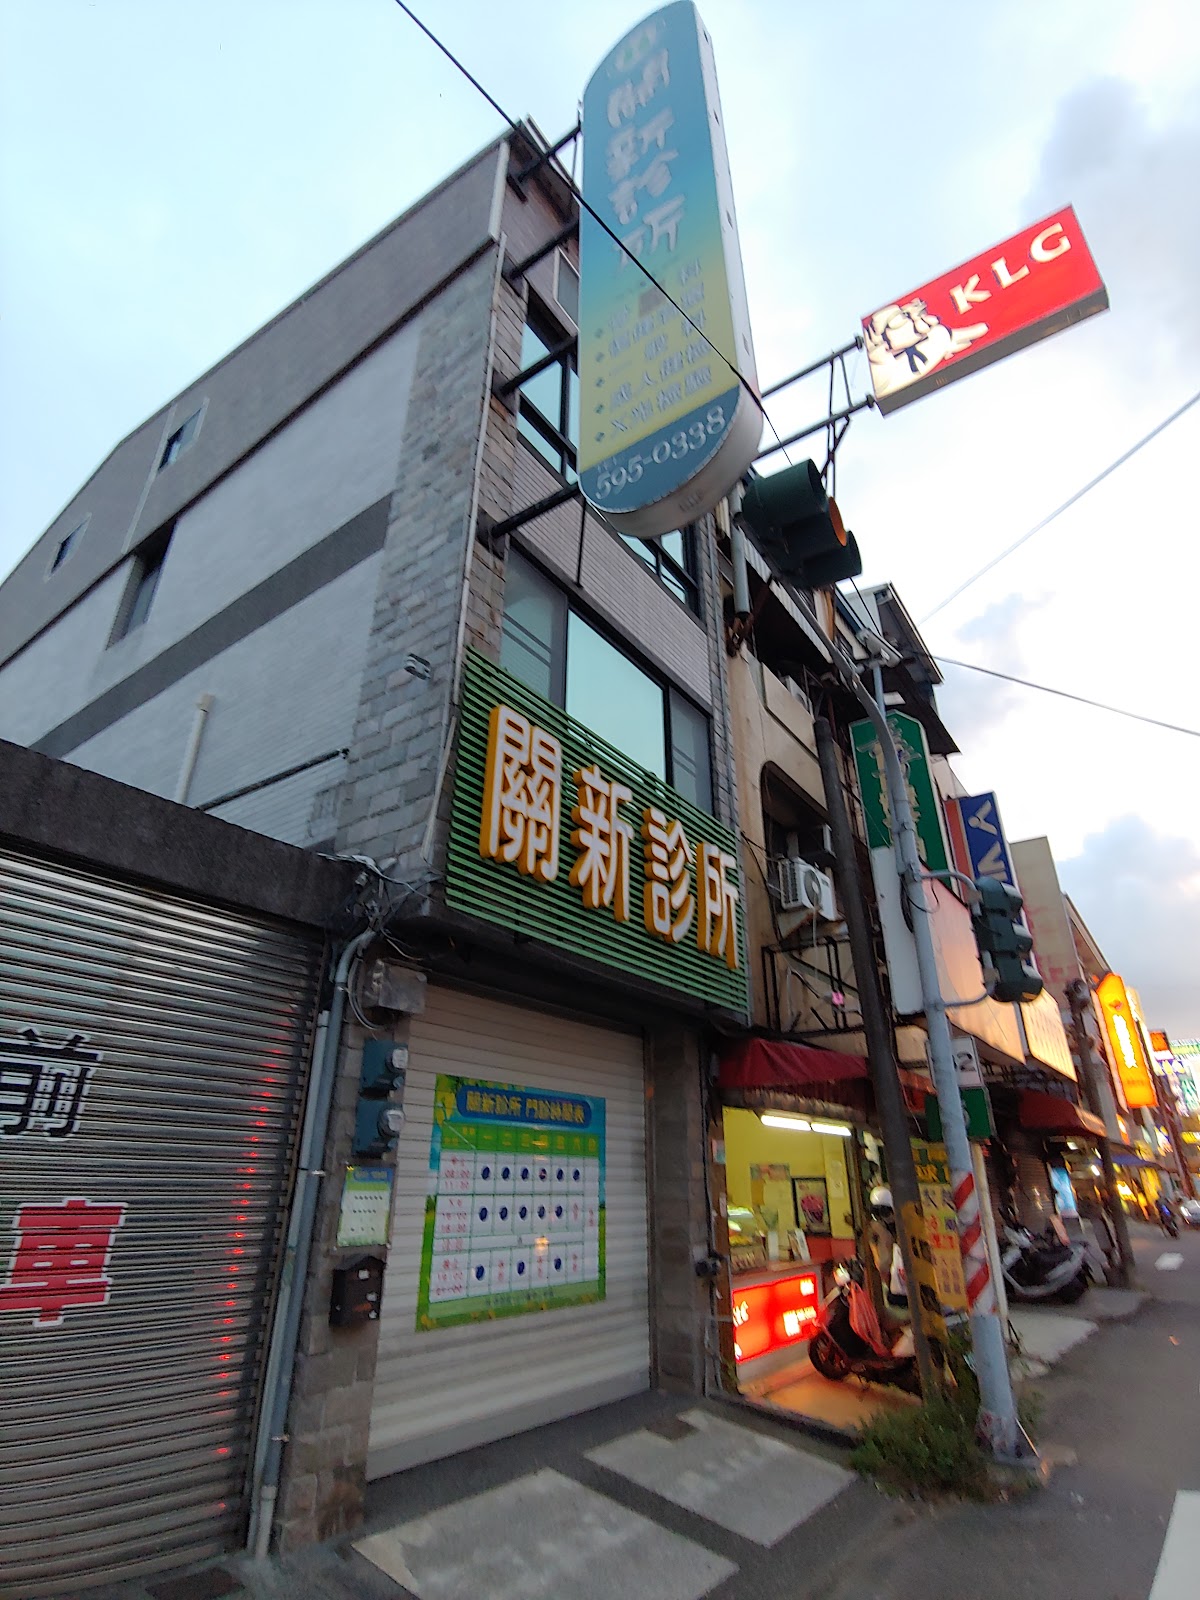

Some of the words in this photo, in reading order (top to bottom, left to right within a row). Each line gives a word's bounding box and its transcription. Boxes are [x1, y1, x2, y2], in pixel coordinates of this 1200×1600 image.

[949, 221, 1072, 315] KLG
[595, 405, 726, 499] 595-0338
[480, 703, 739, 969] 關新診所
